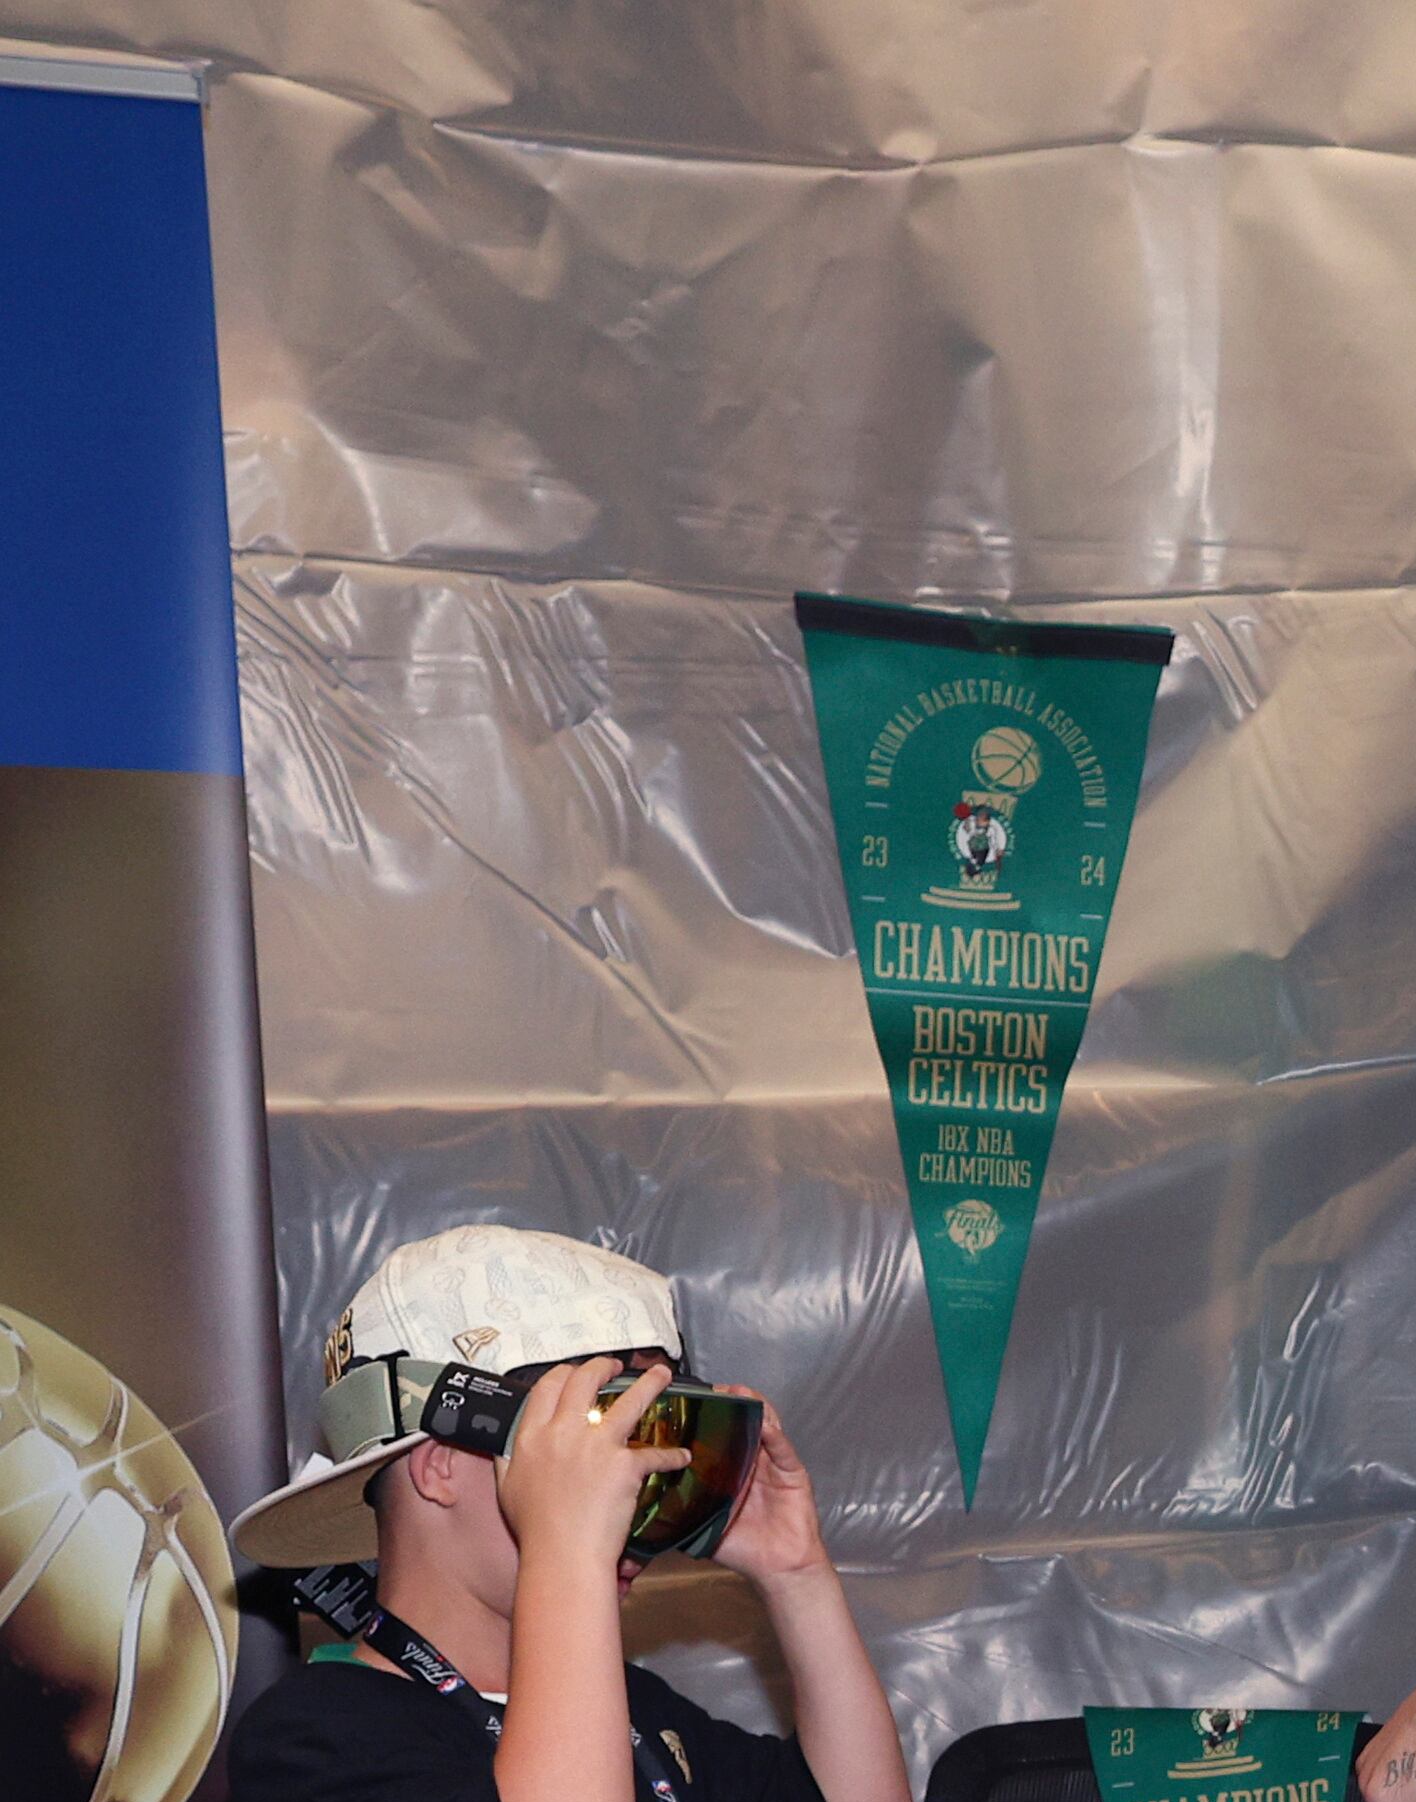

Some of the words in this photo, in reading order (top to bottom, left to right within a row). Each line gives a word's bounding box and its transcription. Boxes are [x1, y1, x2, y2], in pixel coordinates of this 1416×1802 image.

[864, 701, 925, 789] NATIONAL
[916, 679, 1037, 717] BASKETBALL
[1037, 703, 1108, 808] ASSOCIATION
[862, 836, 889, 868] 23
[1080, 855, 1106, 886] 24
[873, 920, 1090, 993] CHAMPIONS
[912, 1004, 1049, 1061] BOSTON
[907, 1057, 1048, 1114] CELTICS
[937, 1124, 970, 1154] 18X
[976, 1128, 1015, 1156] NBA
[918, 1152, 1031, 1189] CHAMPIONS
[1317, 1712, 1341, 1733] 24
[1111, 1728, 1135, 1757] 23
